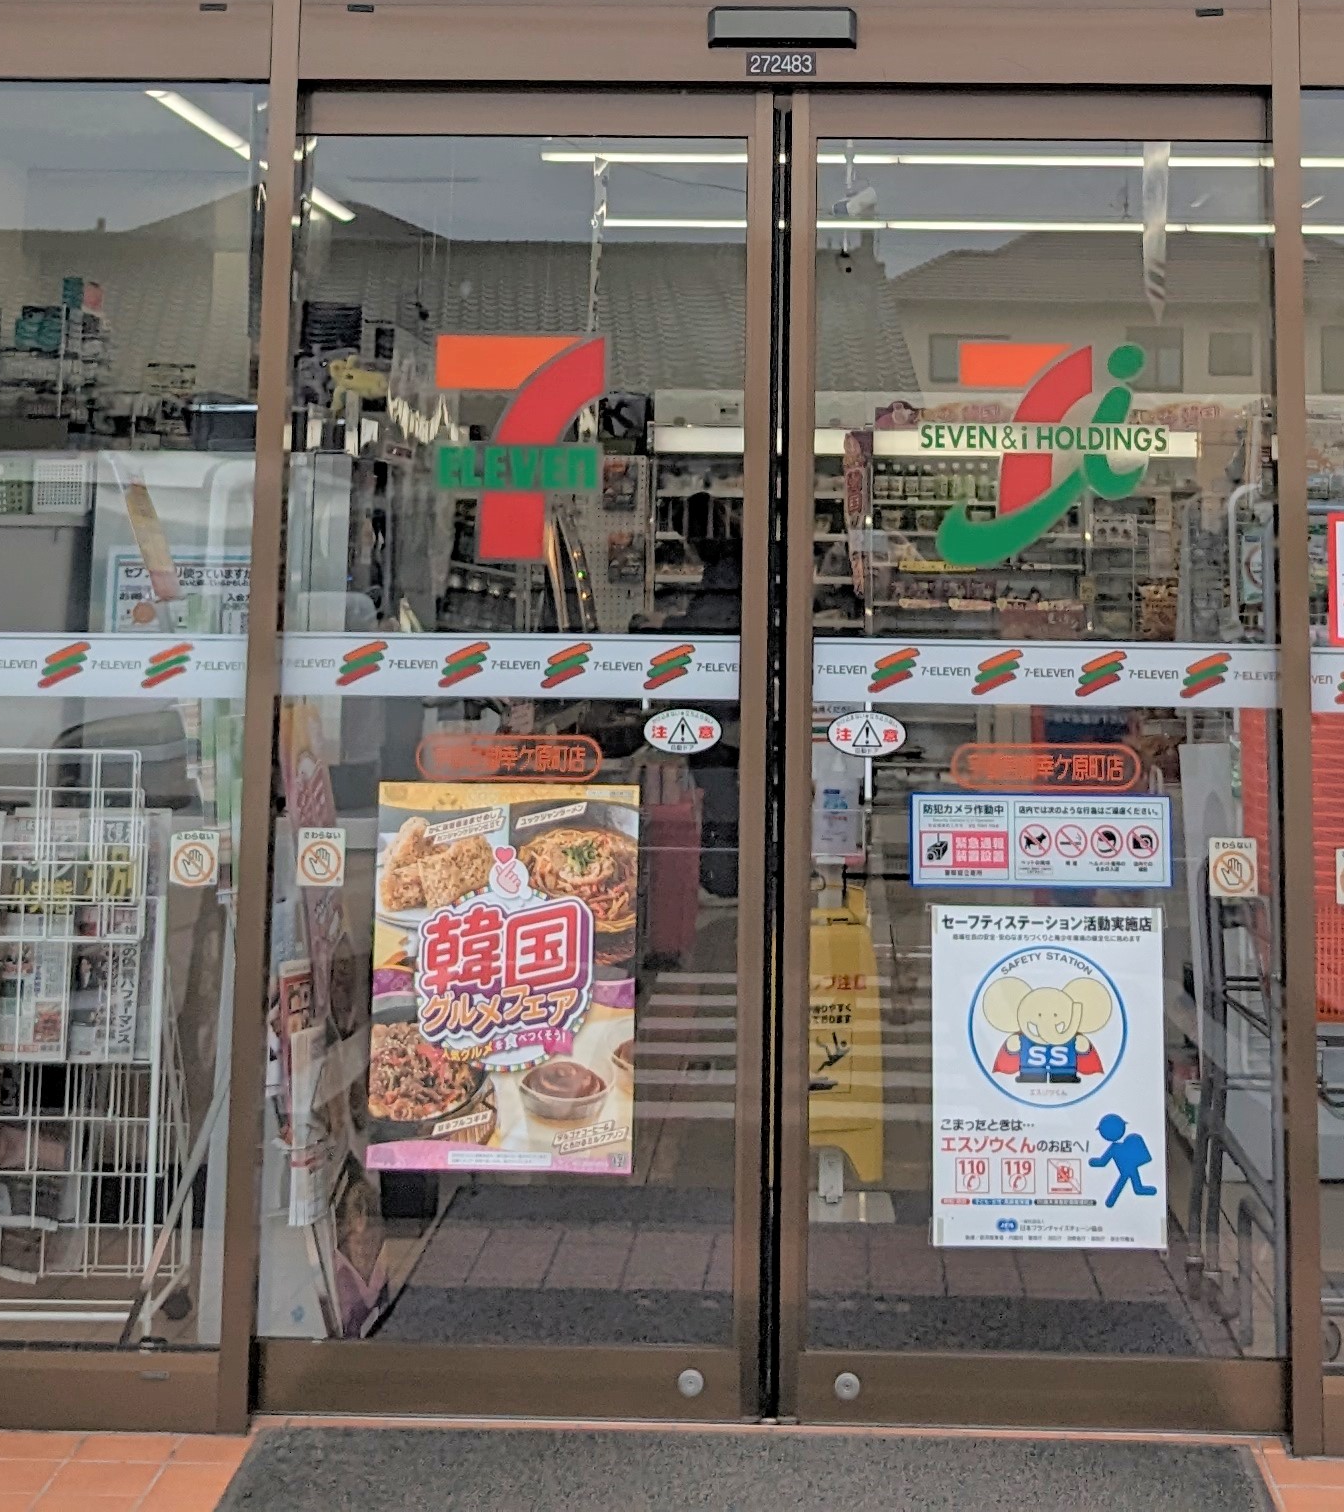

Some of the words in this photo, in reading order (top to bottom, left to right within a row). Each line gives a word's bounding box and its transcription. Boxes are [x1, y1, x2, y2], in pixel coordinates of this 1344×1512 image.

[750, 54, 813, 73] 272483
[1036, 426, 1168, 453] HOLDINGS
[695, 662, 739, 673] 7-ELEVE
[922, 803, 1005, 816] 防犯カメラ作動中
[941, 914, 1153, 932] セーフティステーション活動実施店
[424, 903, 578, 993] 韓国
[1000, 951, 1043, 976] SAFETY
[421, 986, 578, 1034] グルメフェア
[958, 1160, 986, 1175] 110
[1004, 1160, 1032, 1175] 119
